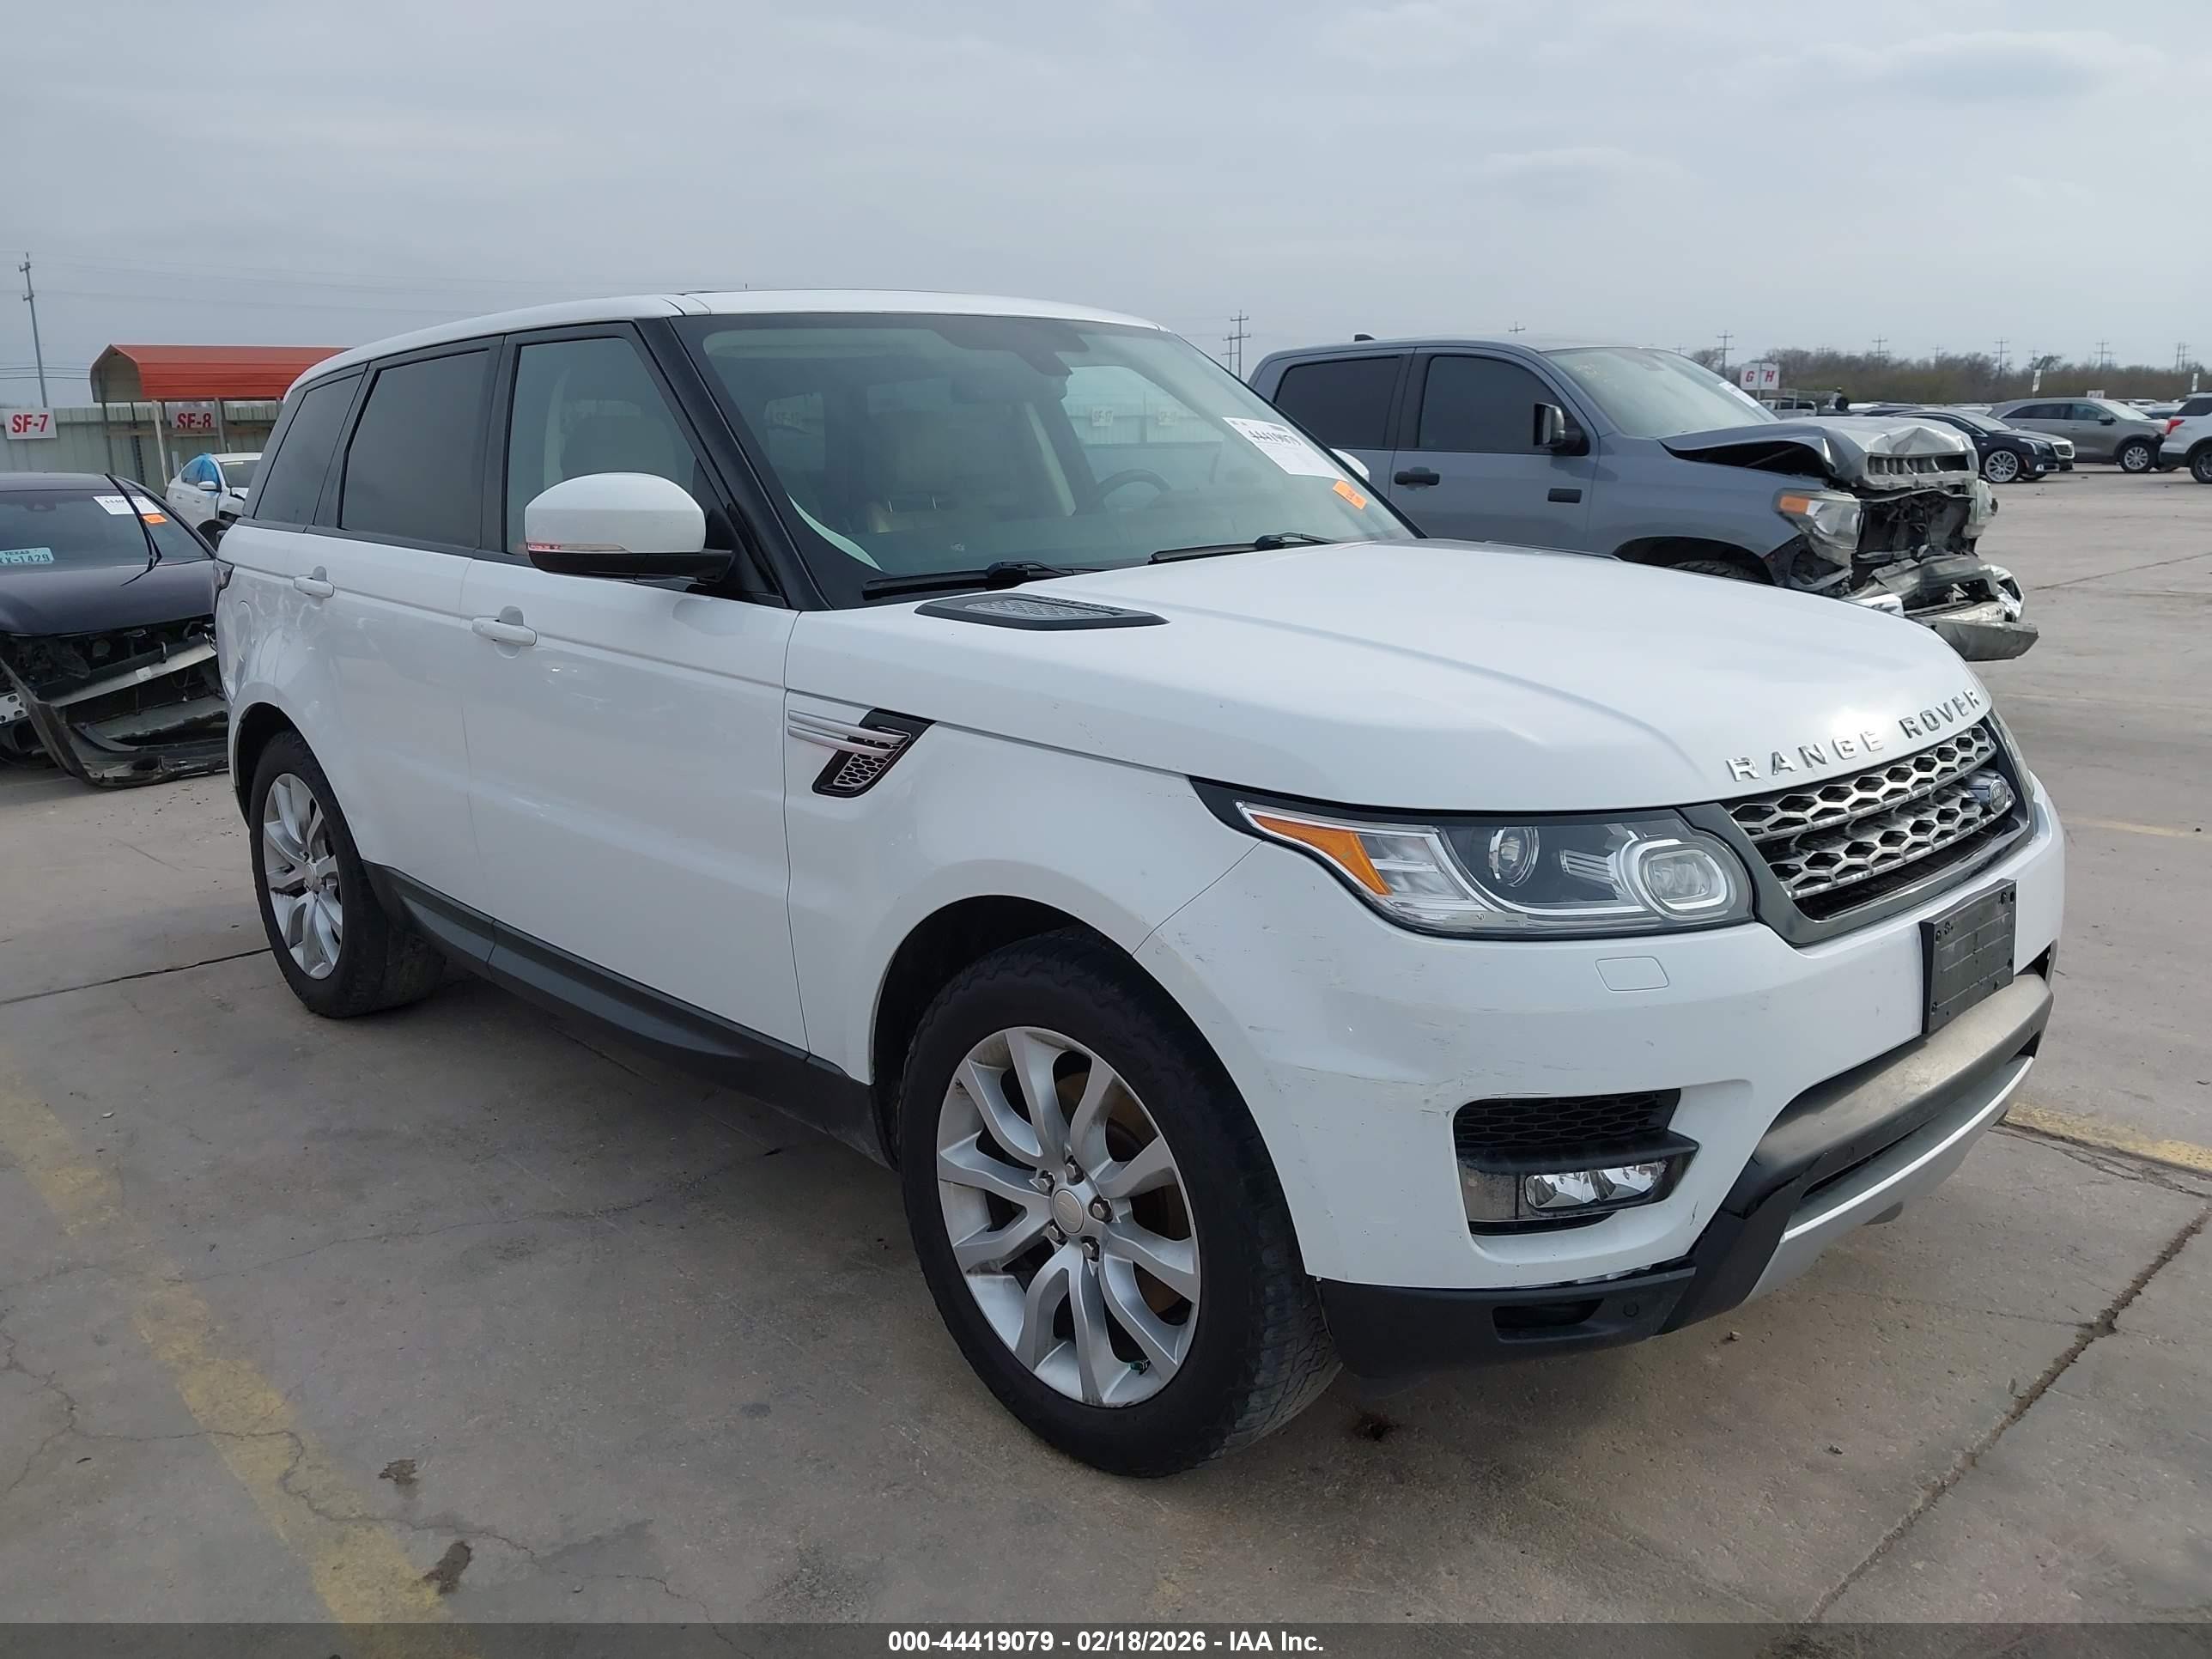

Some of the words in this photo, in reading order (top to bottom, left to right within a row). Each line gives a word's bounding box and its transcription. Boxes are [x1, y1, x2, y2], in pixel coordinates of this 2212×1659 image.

[1747, 371, 1755, 382] G
[1765, 371, 1775, 382] H
[11, 413, 49, 434] SF-7
[176, 413, 212, 428] SF-8
[1725, 730, 1885, 781] RANGE
[1898, 687, 1981, 738] ROVER
